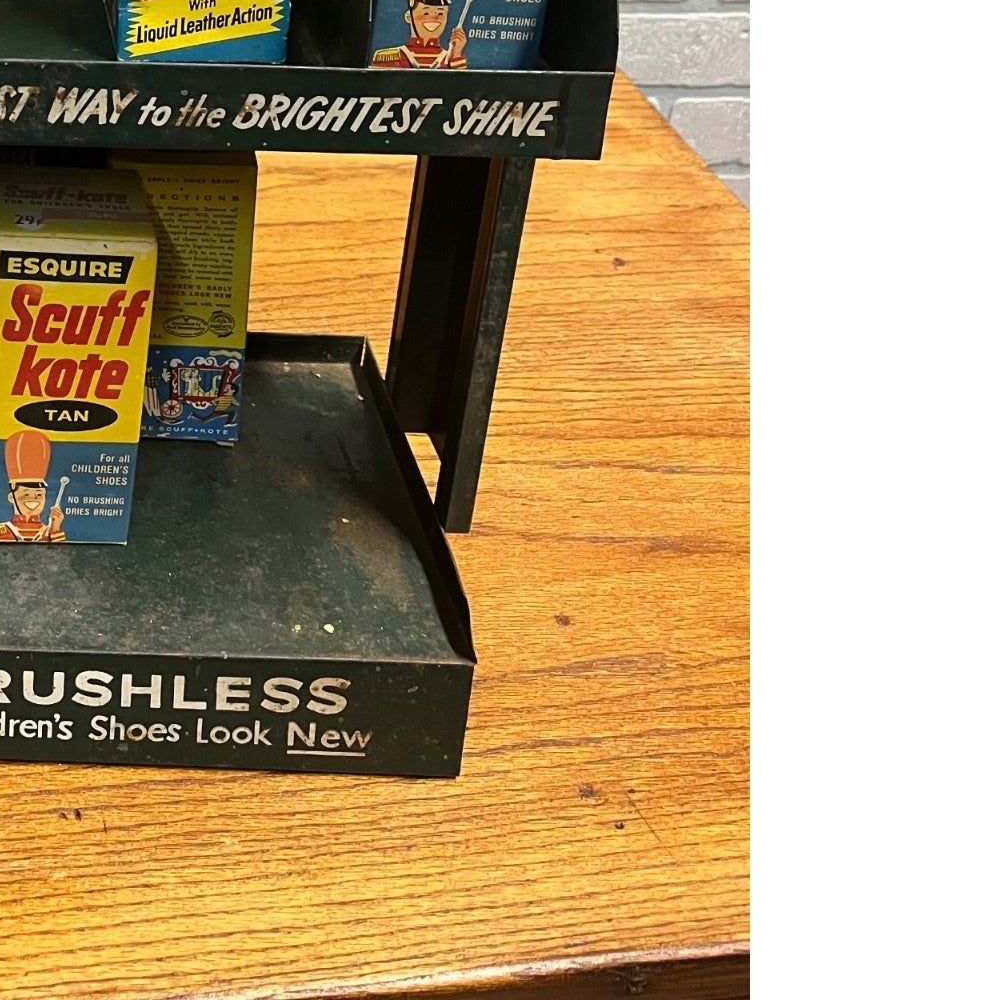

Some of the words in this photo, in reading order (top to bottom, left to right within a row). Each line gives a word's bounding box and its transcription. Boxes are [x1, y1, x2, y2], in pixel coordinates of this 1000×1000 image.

[136, 18, 177, 44] Liquid
[180, 11, 231, 35] Leather
[231, 4, 273, 26] Action
[472, 15, 485, 25] NO
[489, 16, 537, 27] BRUSHING
[469, 30, 497, 39] DRIES
[500, 31, 535, 41] BRIGHT
[47, 86, 140, 125] WAY
[137, 97, 172, 127] to
[174, 94, 225, 128] the
[232, 93, 442, 133] BRIGHTEST
[442, 98, 560, 138] SHINE
[146, 193, 239, 201] RECTIONS
[7, 256, 123, 278] ESQUIRE
[1, 283, 151, 346] Scuff
[11, 344, 130, 400] kote
[44, 409, 90, 422] TAN
[100, 453, 116, 462] For
[119, 454, 131, 463] all
[71, 464, 129, 474] CHILDREN'S
[95, 476, 128, 486] SHOES
[67, 496, 79, 504] NO
[83, 497, 125, 506] BRUSHING
[65, 507, 90, 516] DRIES
[94, 507, 124, 516] BRIGHT
[88, 714, 182, 743] Shoes
[196, 718, 273, 747] Look
[286, 721, 374, 750] New
